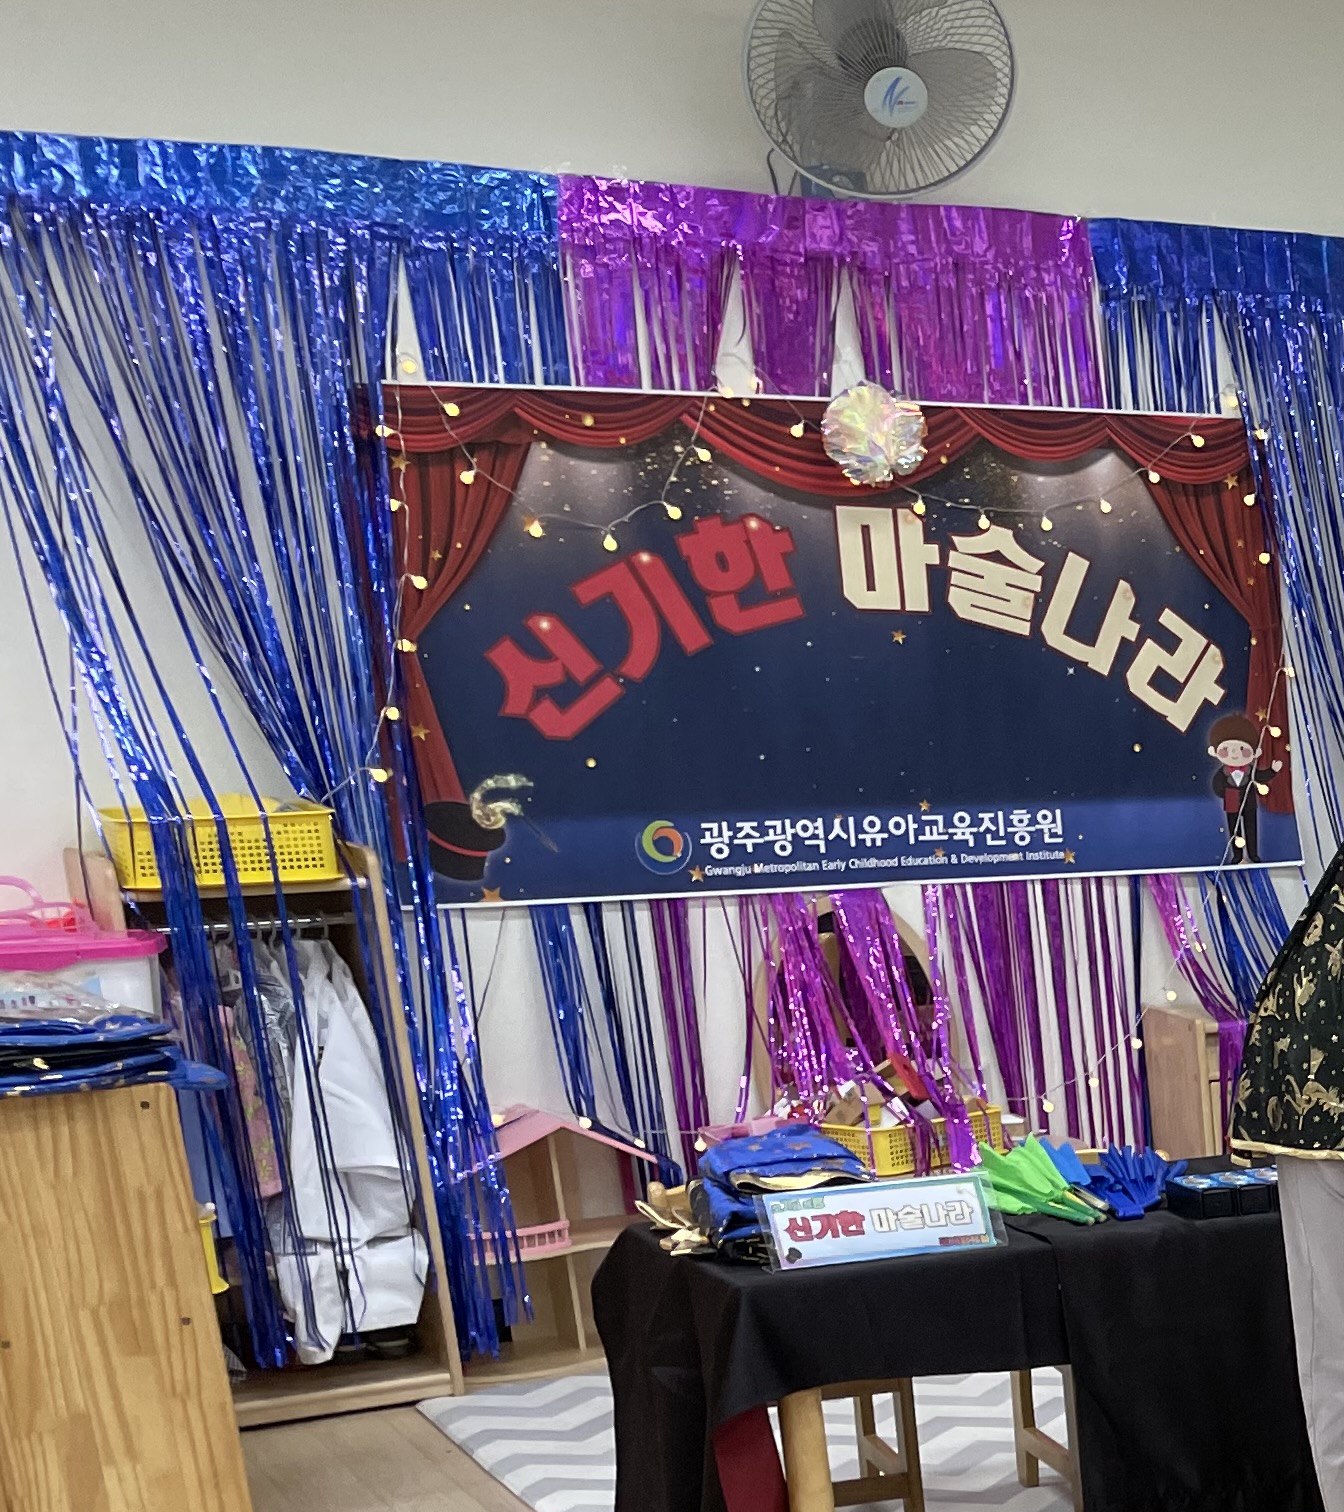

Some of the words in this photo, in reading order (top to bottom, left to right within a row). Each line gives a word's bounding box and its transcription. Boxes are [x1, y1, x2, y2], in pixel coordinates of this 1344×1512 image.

[485, 512, 804, 740] 신기한
[835, 504, 1228, 732] 마술나라
[699, 808, 1064, 860] 광주광역시유아교육진흥원
[704, 864, 751, 877] Gwangju
[754, 861, 820, 874] Metropolitan
[822, 858, 847, 872] Early
[848, 857, 898, 869] Childhood
[901, 854, 948, 866] Education
[950, 854, 958, 864] &
[1026, 850, 1065, 860] Institute
[785, 1210, 866, 1242] 신기한
[869, 1200, 974, 1233] 마술나라
